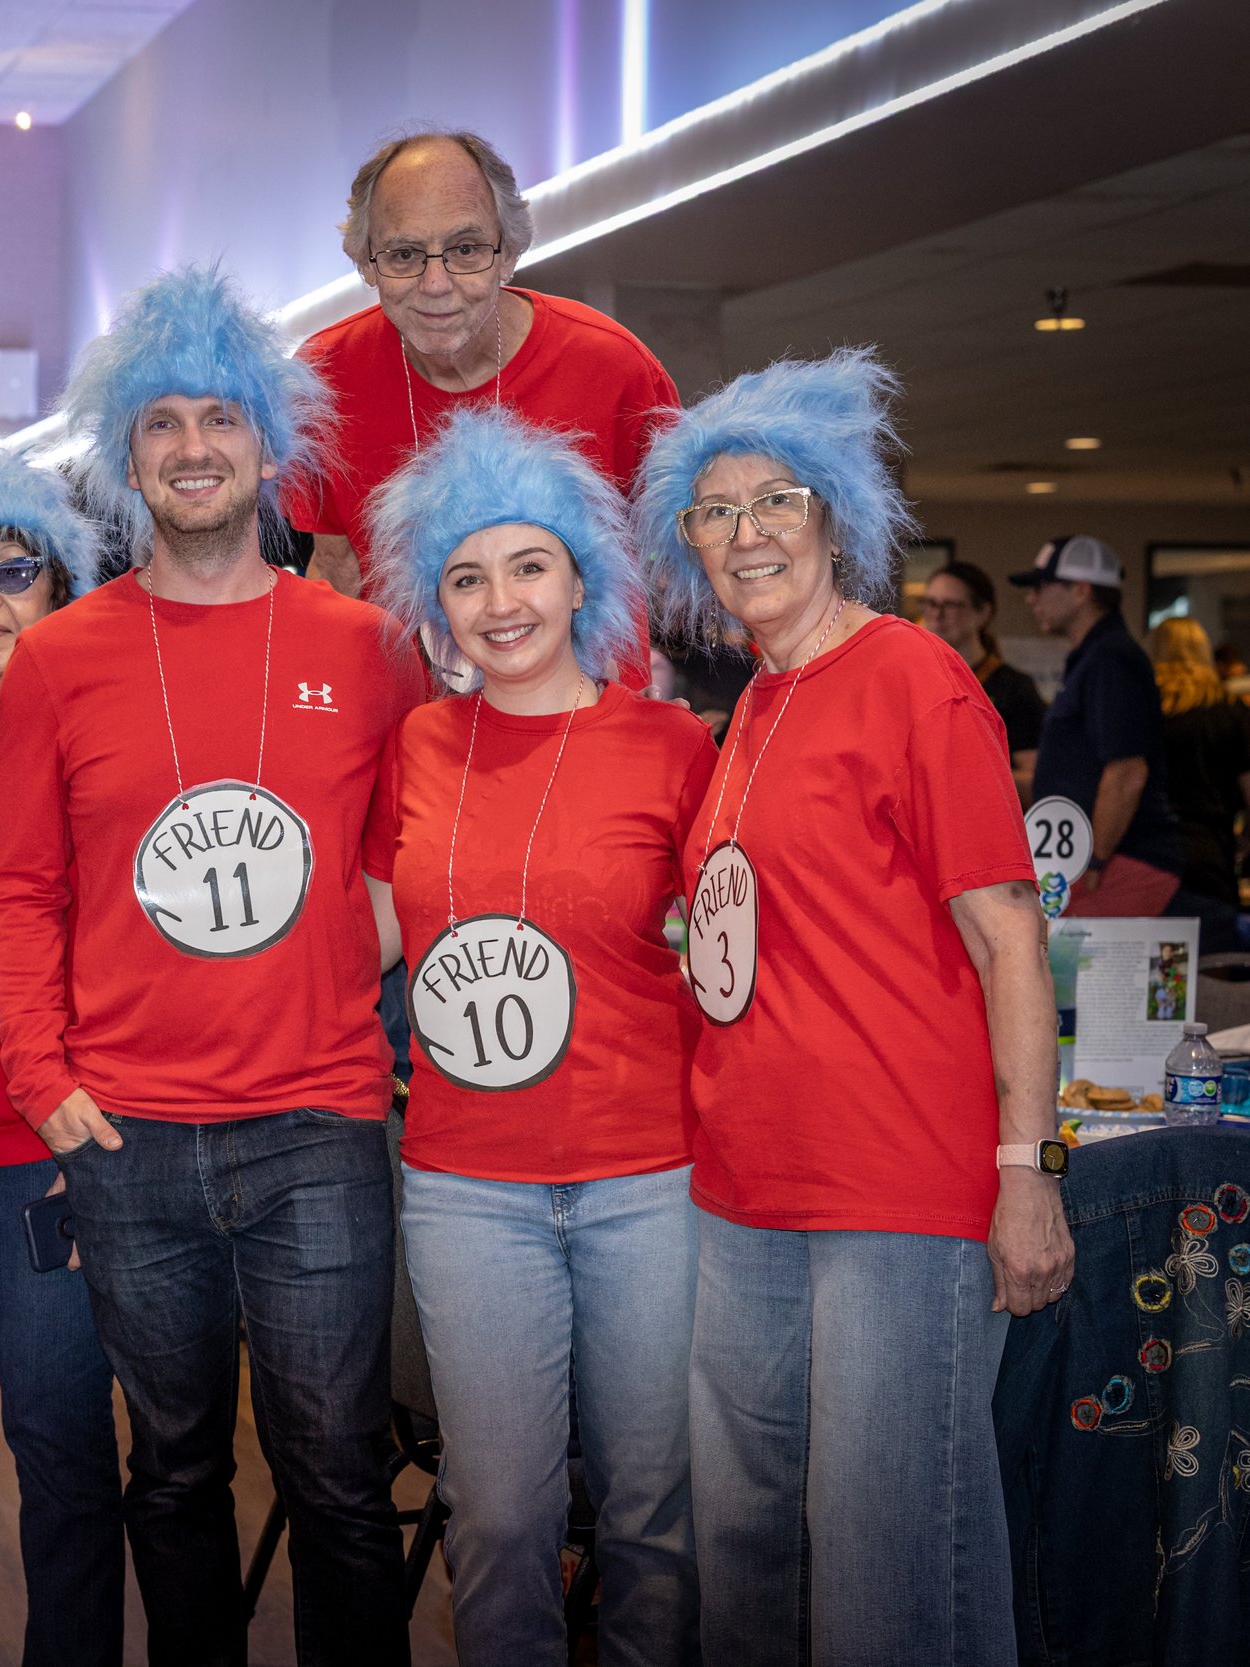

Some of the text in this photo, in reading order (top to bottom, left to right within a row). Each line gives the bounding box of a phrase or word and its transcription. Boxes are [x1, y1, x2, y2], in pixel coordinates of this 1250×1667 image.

[314, 705, 339, 713] ARMOUR
[152, 808, 285, 871] FRIEND
[1034, 819, 1074, 859] 28
[202, 861, 260, 932] 11
[693, 863, 748, 940] FRIEND
[422, 936, 550, 1004] FRIEND
[717, 930, 735, 998] 3
[463, 994, 534, 1068] 10
